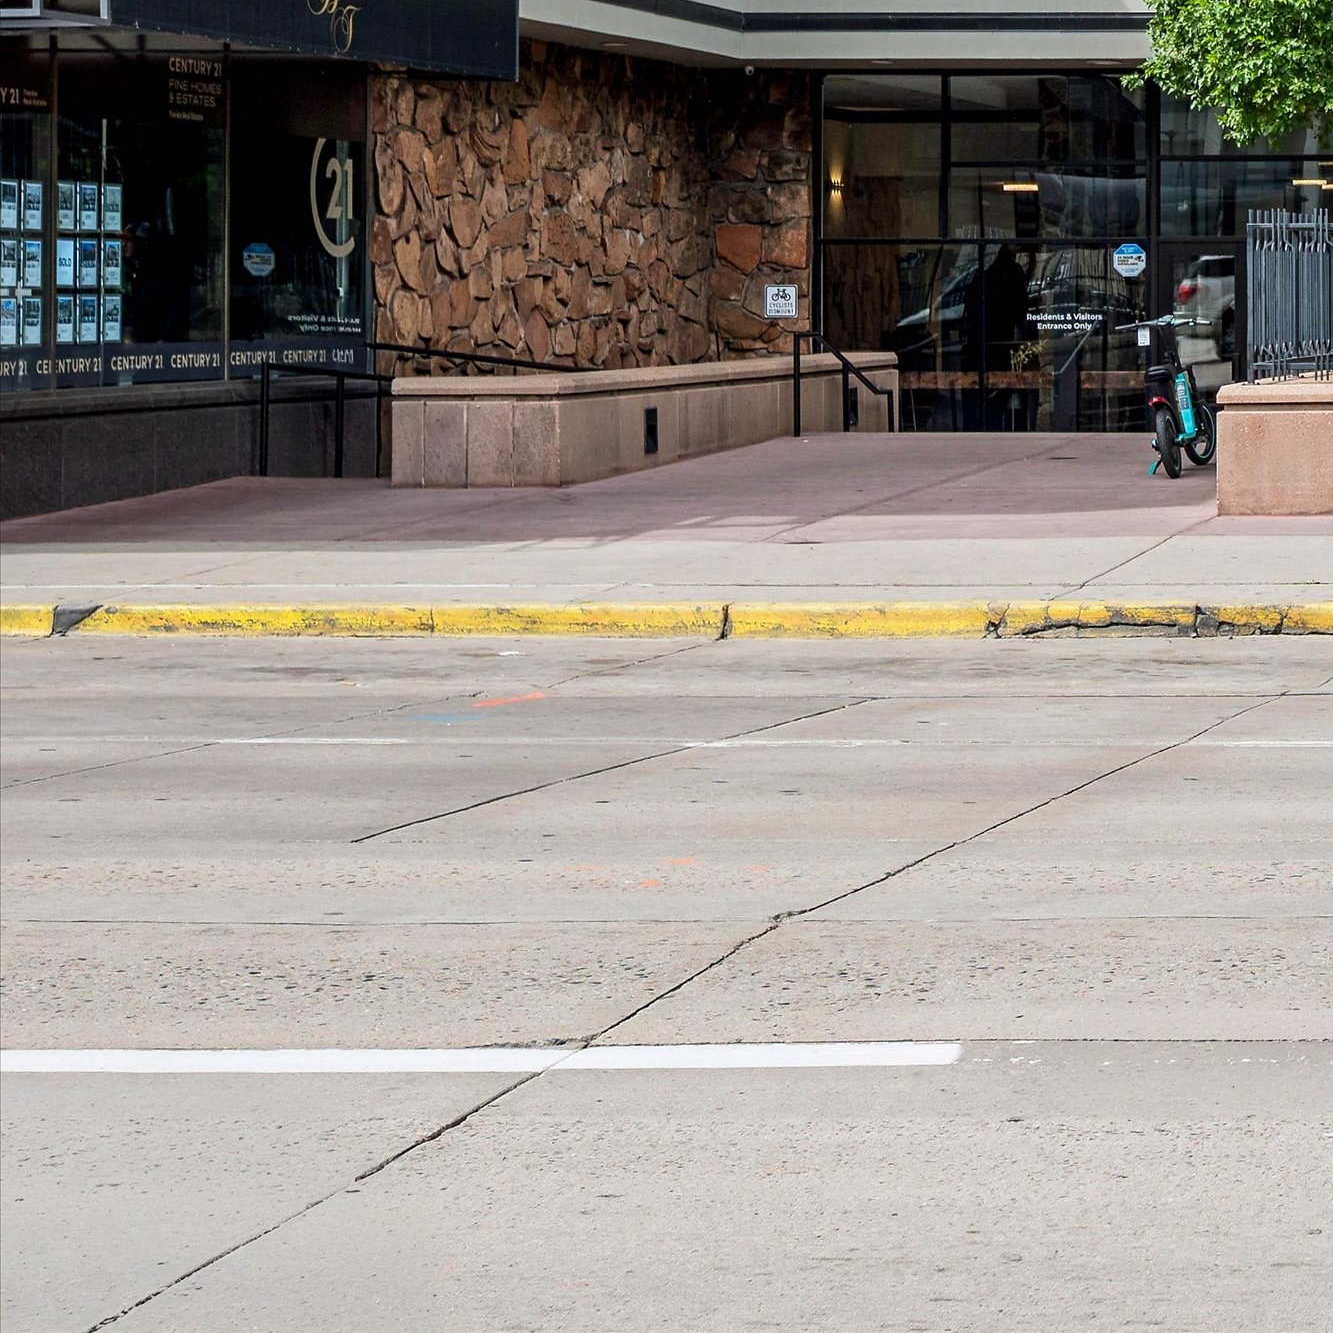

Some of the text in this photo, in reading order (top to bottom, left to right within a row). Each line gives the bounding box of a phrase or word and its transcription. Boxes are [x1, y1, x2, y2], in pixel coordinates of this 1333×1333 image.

[169, 57, 222, 77] CENTURY 21
[168, 78, 222, 95] FINE HOMES
[10, 87, 19, 105] 21
[58, 257, 72, 267] SOLD
[1026, 312, 1103, 321] Residents & Visitors
[1036, 321, 1093, 331] Entrance Only
[110, 354, 164, 371] CENTURY 21
[170, 353, 220, 368] CENTURY 21
[230, 350, 276, 365] CENTURY 21
[282, 349, 319, 363] CENTURY
[319, 349, 327, 362] 21
[18, 360, 28, 375] 21
[93, 357, 102, 372] 21
